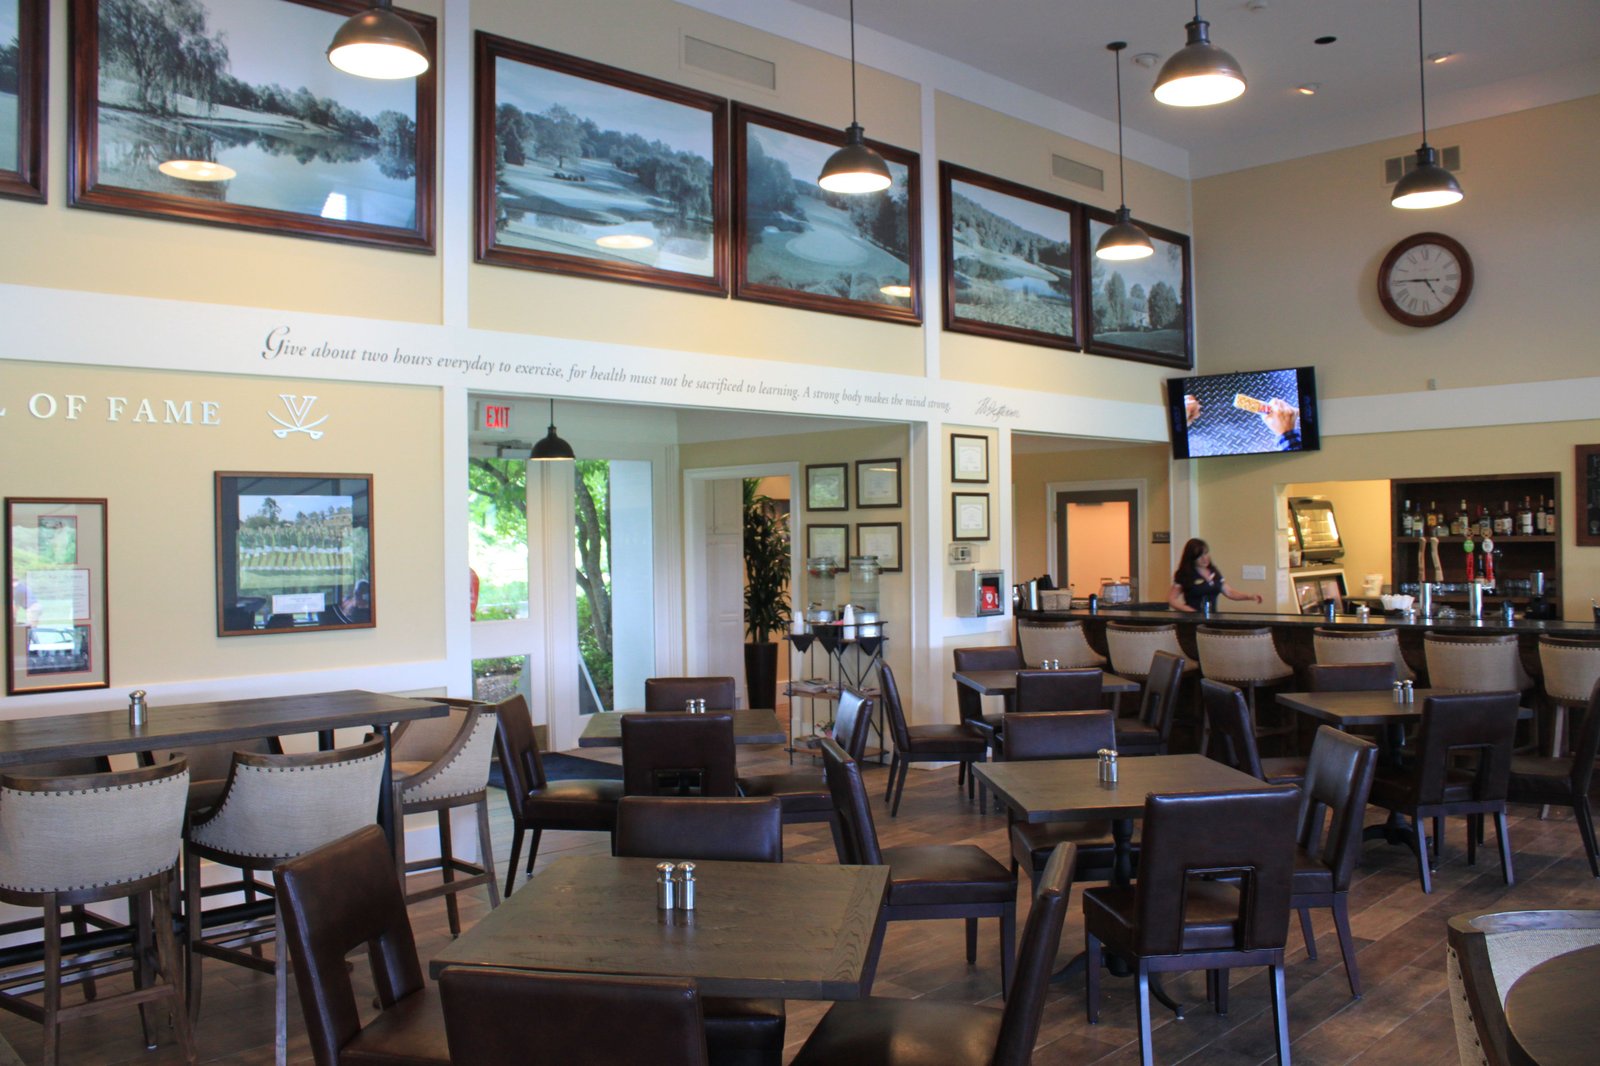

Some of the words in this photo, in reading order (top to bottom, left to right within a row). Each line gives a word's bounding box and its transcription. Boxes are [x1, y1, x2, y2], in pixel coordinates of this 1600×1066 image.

[261, 325, 307, 360] Give
[311, 342, 356, 361] about
[361, 350, 388, 363] two
[393, 347, 433, 367] hours
[437, 355, 495, 376] everyday
[499, 360, 511, 373] to
[515, 363, 564, 378] exercise,
[566, 364, 587, 382] for
[590, 365, 626, 383] health
[630, 374, 657, 385] must
[660, 377, 678, 387] not
[681, 374, 696, 389] be
[695, 377, 744, 395] sacrificed
[746, 383, 756, 394] to
[758, 381, 800, 401] learning.
[803, 386, 811, 398] A
[812, 389, 840, 404] strong
[842, 389, 862, 406] body
[864, 391, 889, 405] makes
[891, 393, 904, 406] the
[905, 396, 926, 408] mind
[927, 399, 951, 413] strong.
[28, 392, 88, 421] OF
[106, 396, 222, 426] FAME
[486, 405, 511, 428] EXIT
